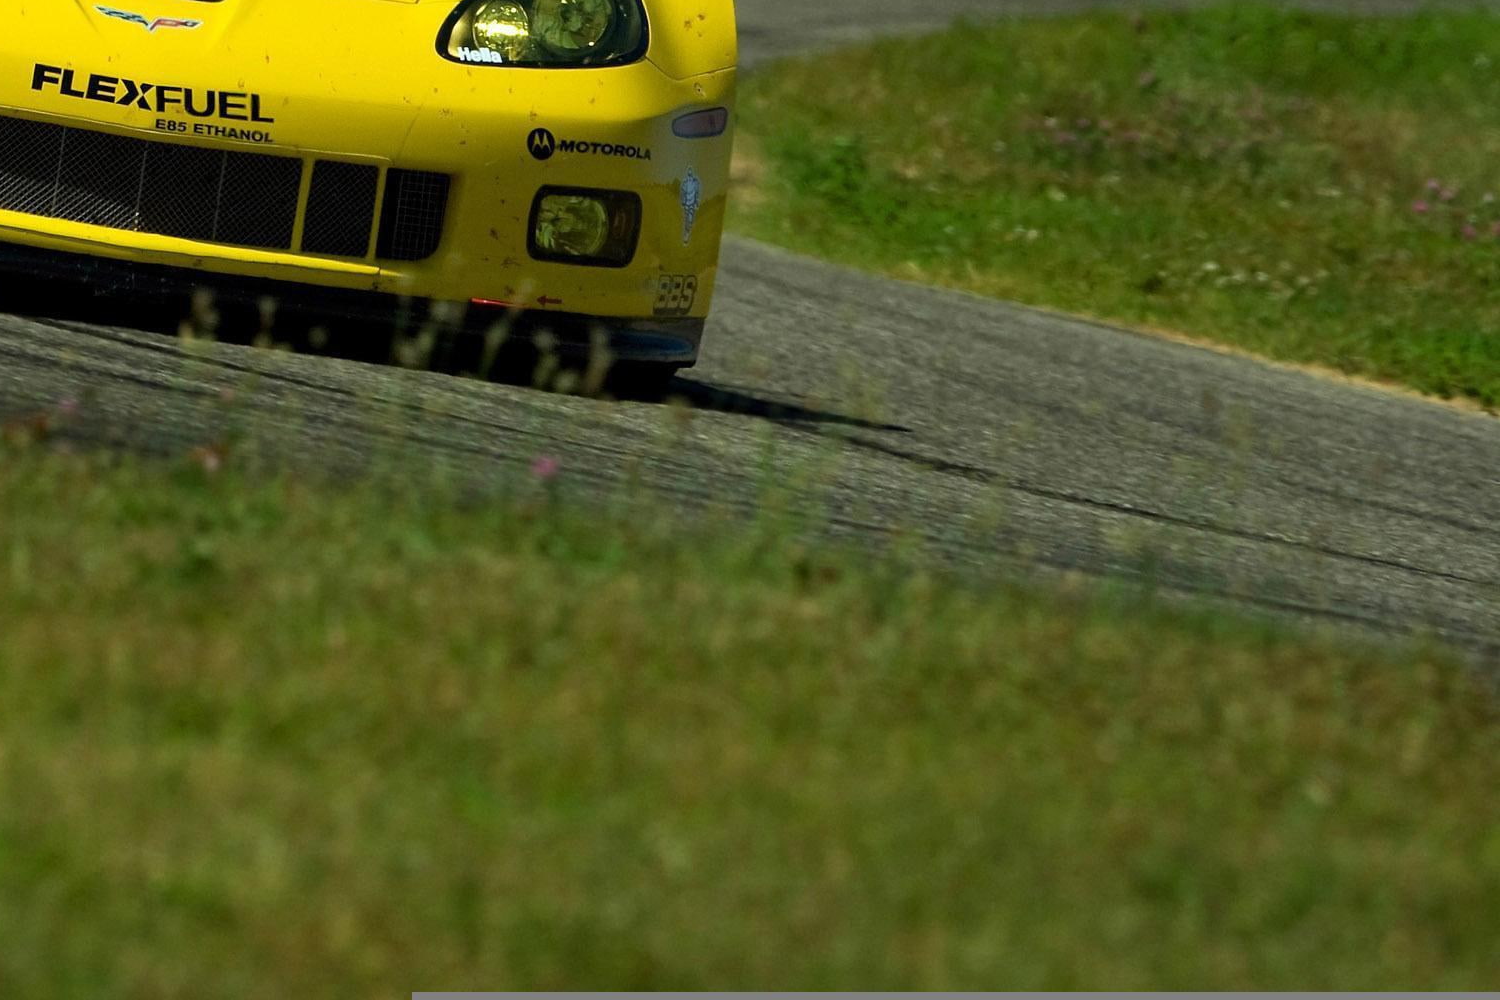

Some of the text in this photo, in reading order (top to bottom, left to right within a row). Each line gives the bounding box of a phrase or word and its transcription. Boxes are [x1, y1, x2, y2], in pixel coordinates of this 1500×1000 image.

[457, 46, 503, 63] Hella
[31, 63, 275, 124] FLEXFUEL
[155, 118, 275, 143] E85 ETHANOL
[558, 139, 652, 161] MOTOROLA
[653, 274, 699, 316] BBS
